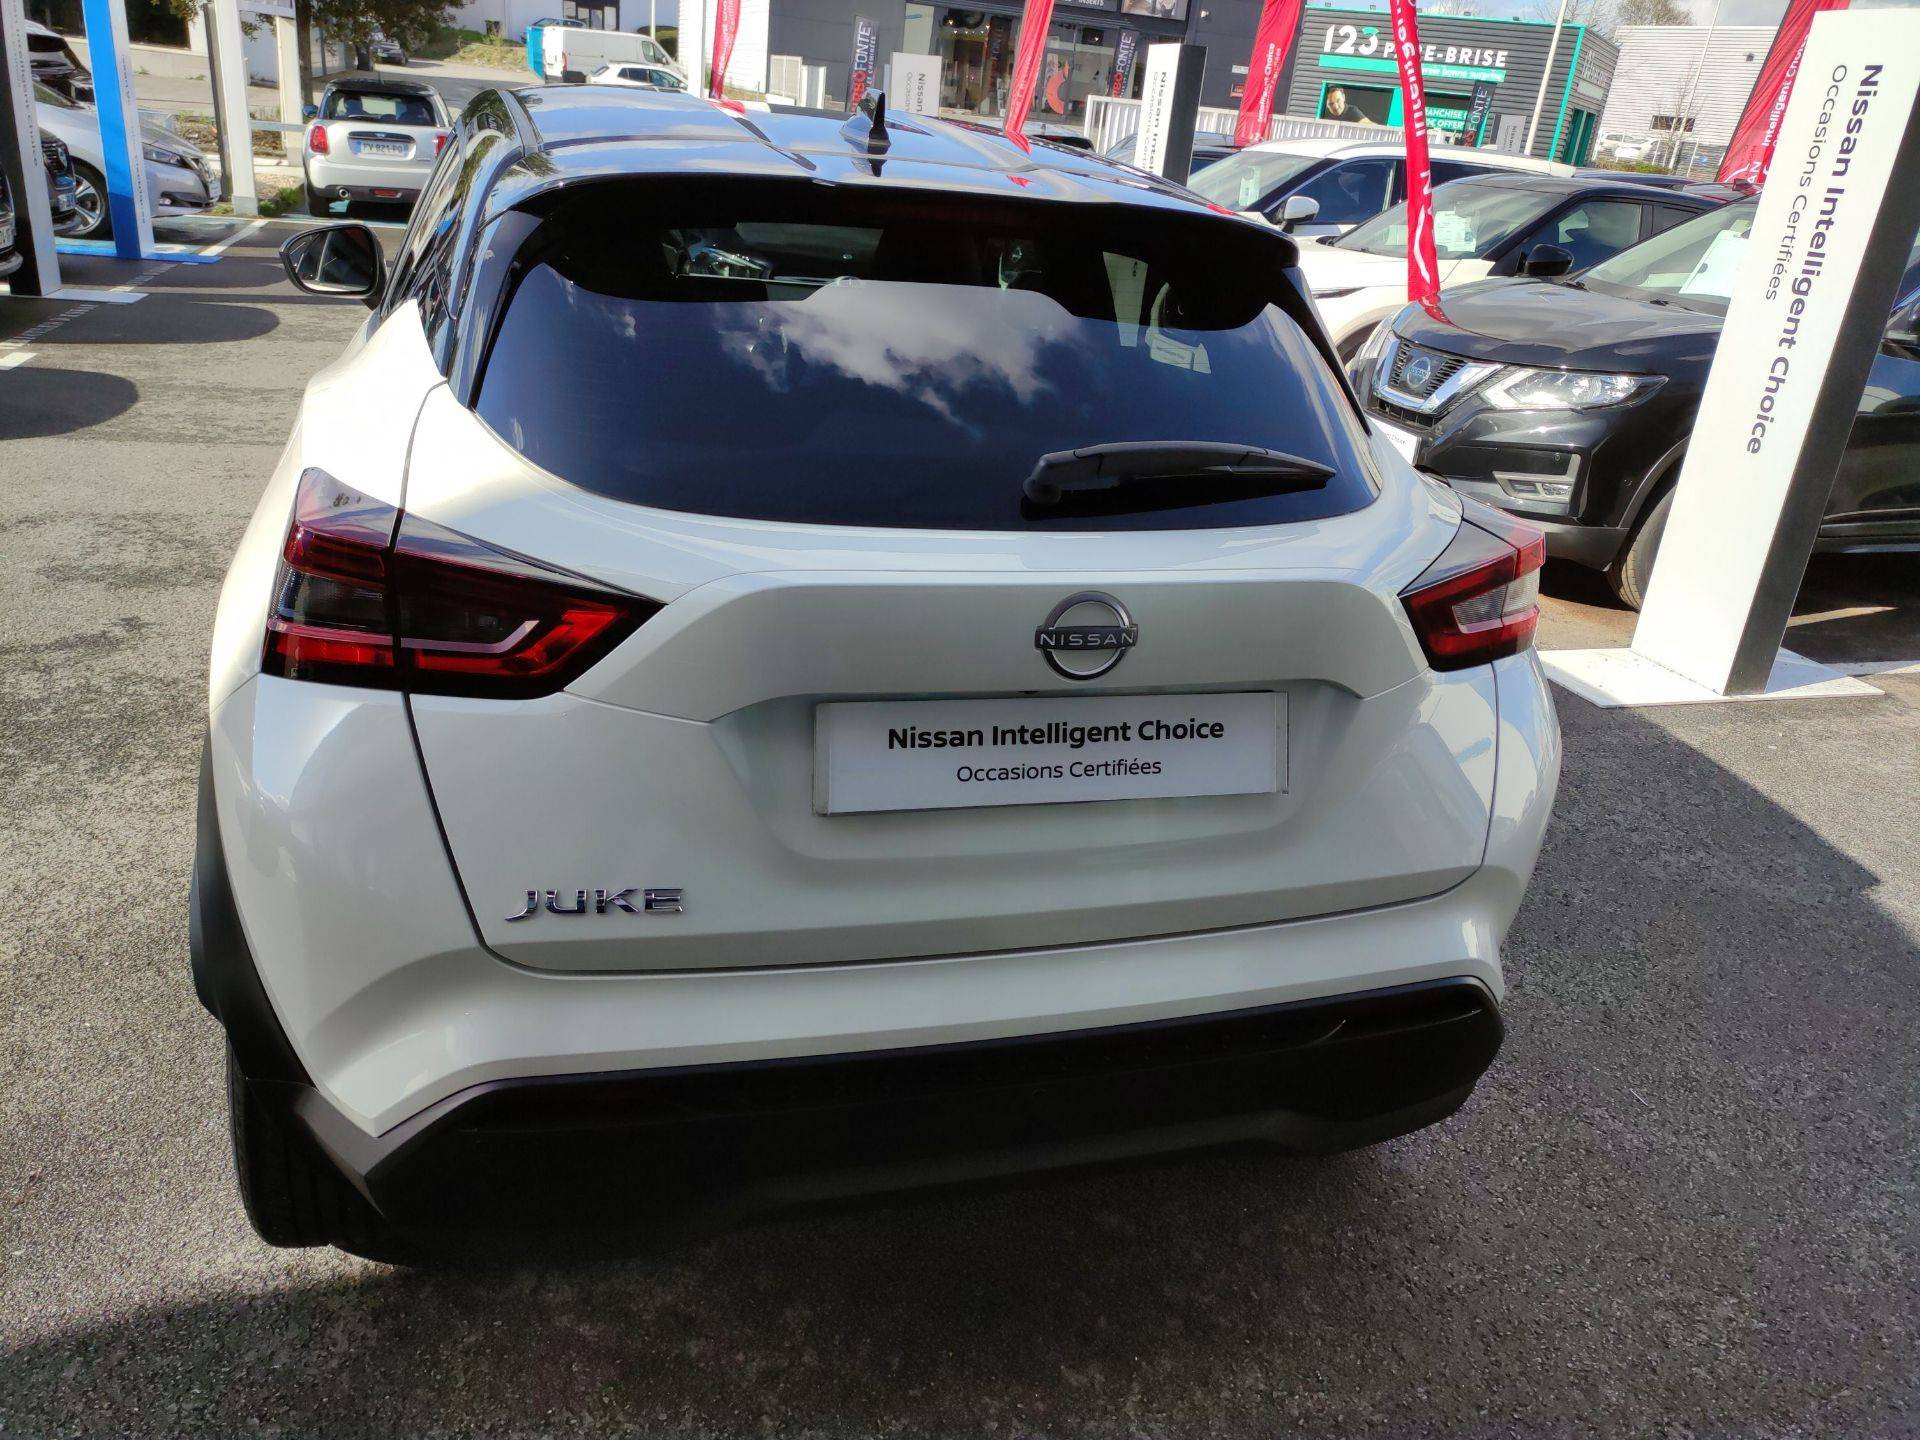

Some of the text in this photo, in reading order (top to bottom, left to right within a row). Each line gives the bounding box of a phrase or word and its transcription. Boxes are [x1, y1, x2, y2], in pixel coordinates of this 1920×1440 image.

[1323, 25, 1509, 68] 123 PE-BRISE
[916, 72, 927, 112] Nissan
[1155, 71, 1167, 128] Nissan
[1761, 80, 1792, 147] Intelligent
[1765, 64, 1848, 301] Occasions Certifiées
[1746, 64, 1884, 454] Nissan Intelligent Choice
[1040, 632, 1136, 646] NISSAN
[888, 718, 1225, 749] Nissan Intelligent Choice
[956, 758, 1162, 783] Occasions Certifiées
[503, 888, 684, 921] JUKE
